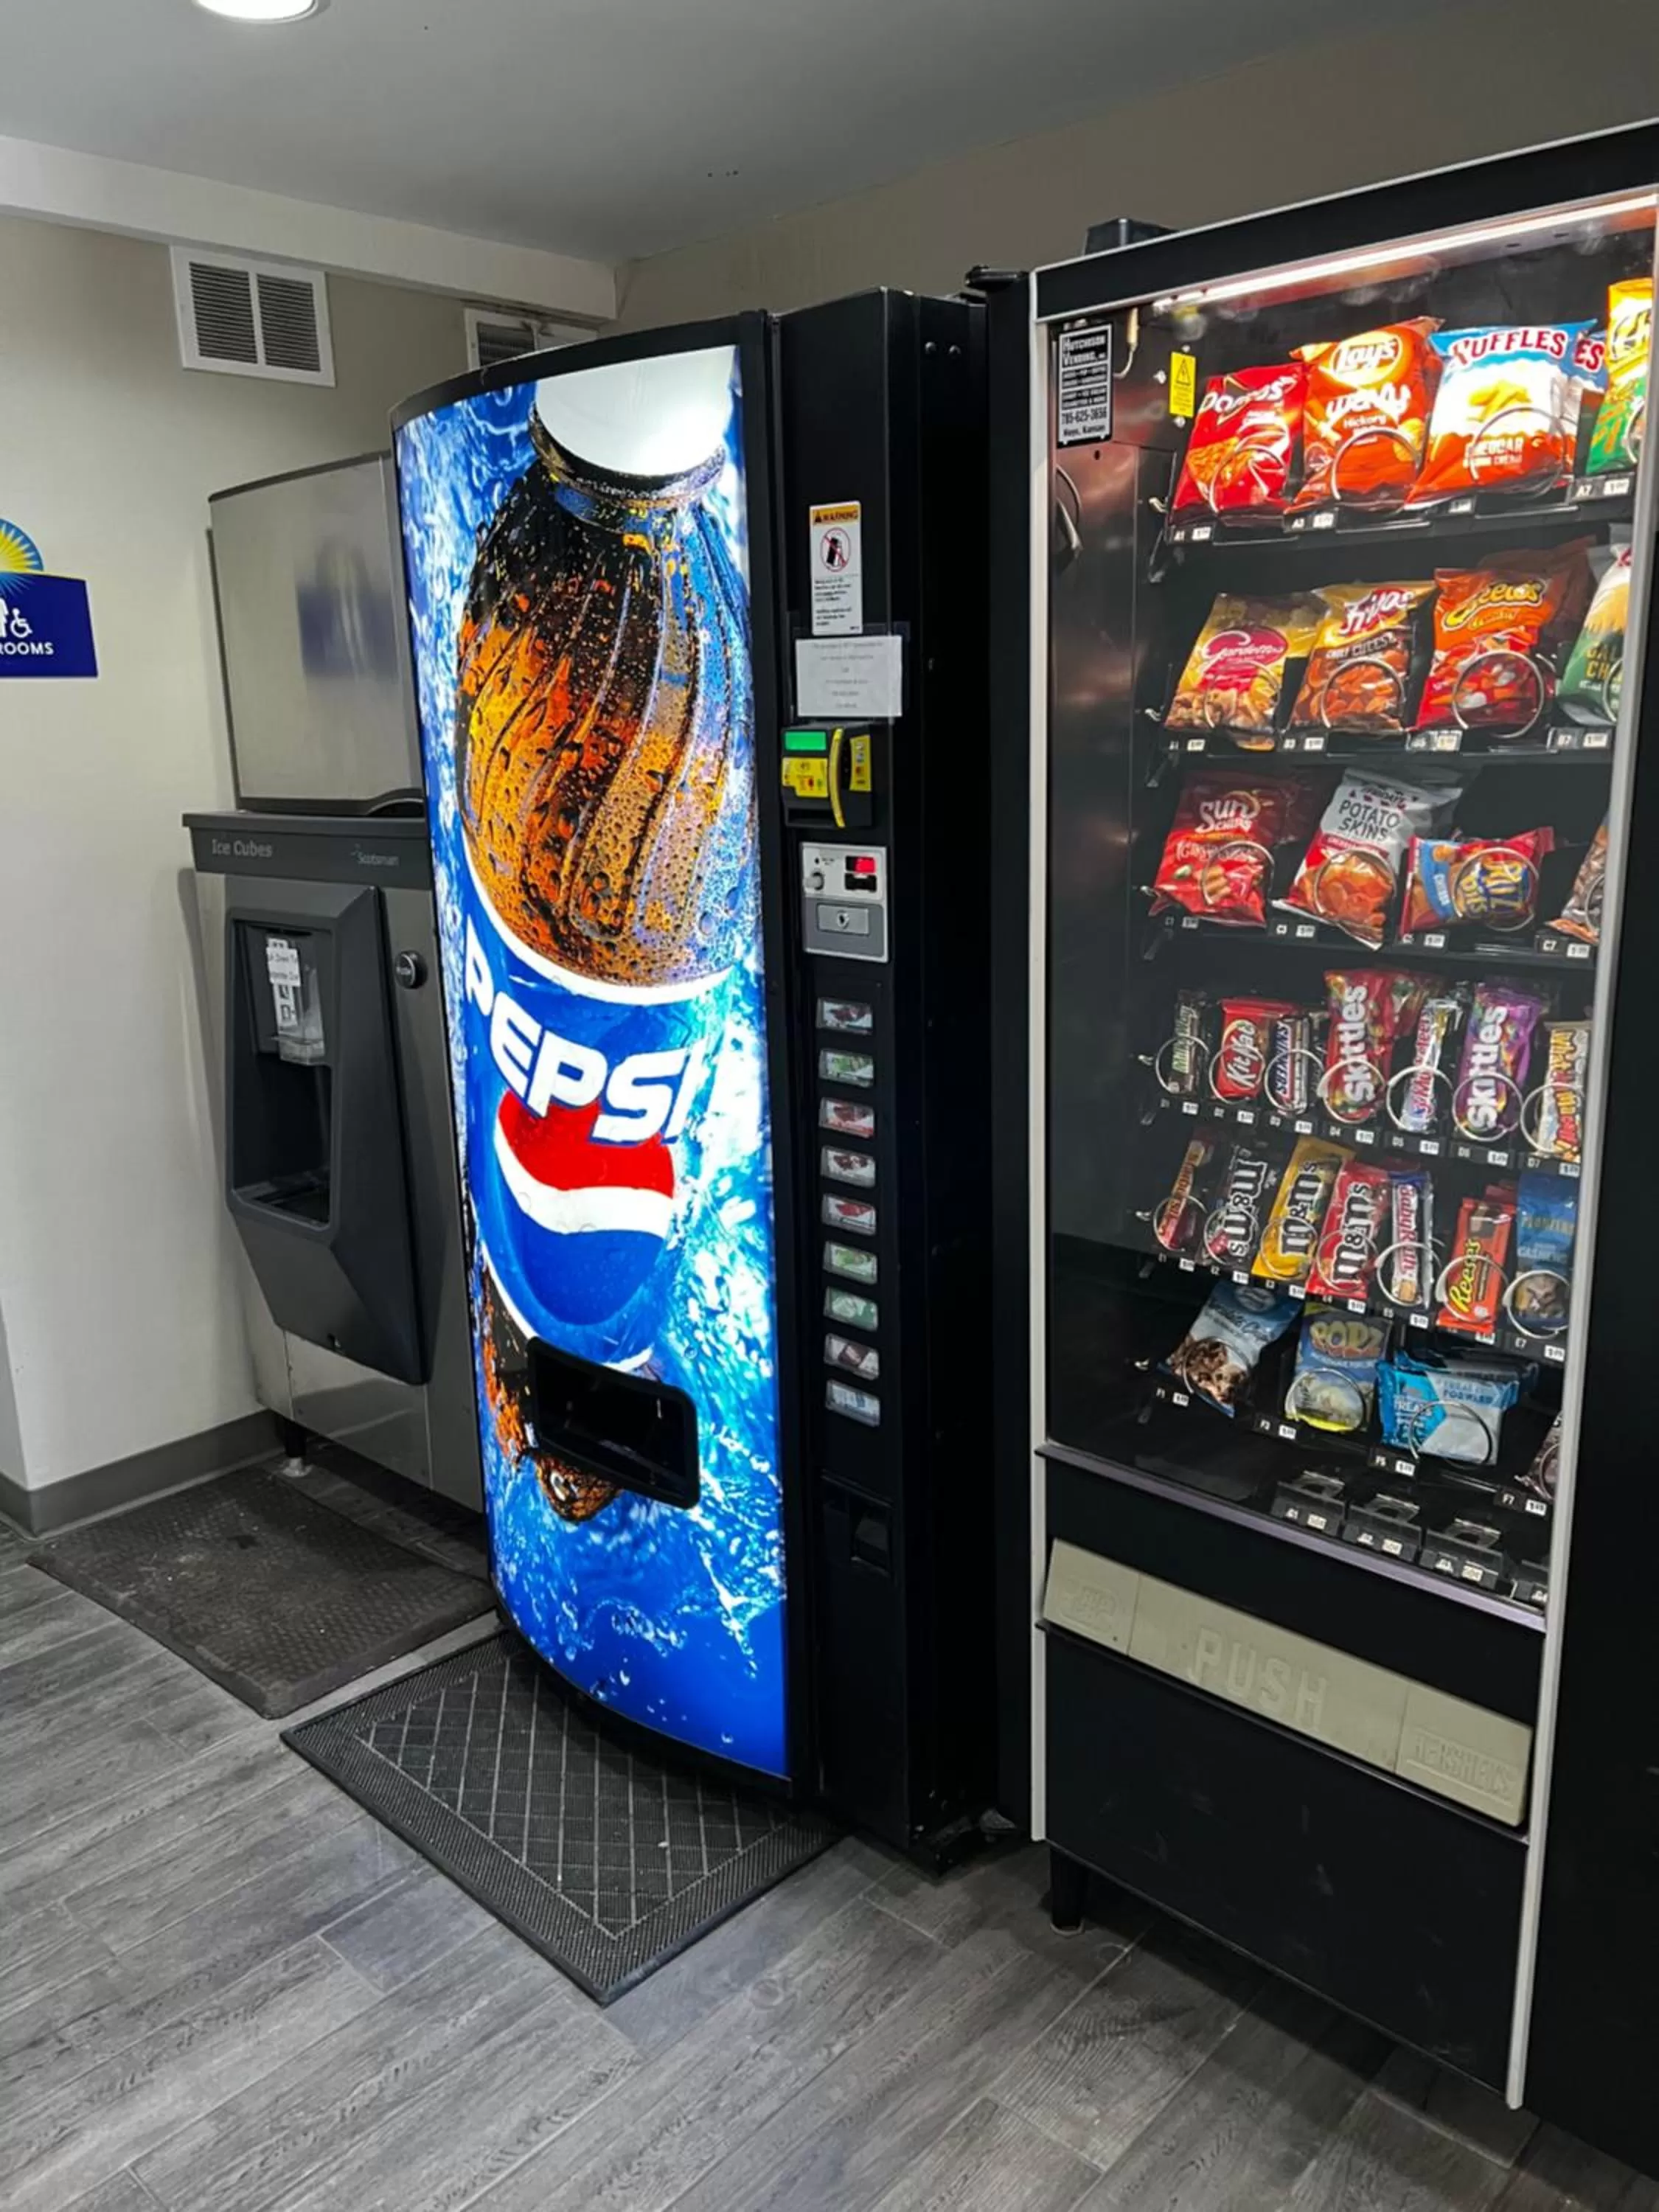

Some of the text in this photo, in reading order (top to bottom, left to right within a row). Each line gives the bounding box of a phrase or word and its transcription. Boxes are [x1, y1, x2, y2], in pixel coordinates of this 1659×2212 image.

[212, 838, 273, 858] Ice Cubes
[1338, 799, 1400, 829] POTATO
[1338, 815, 1389, 841] SKINS
[465, 914, 709, 1143] PEPSI
[1336, 985, 1368, 1103] Skittles
[1466, 1005, 1509, 1130] Skittles
[1189, 1625, 1328, 1733] PUSH
